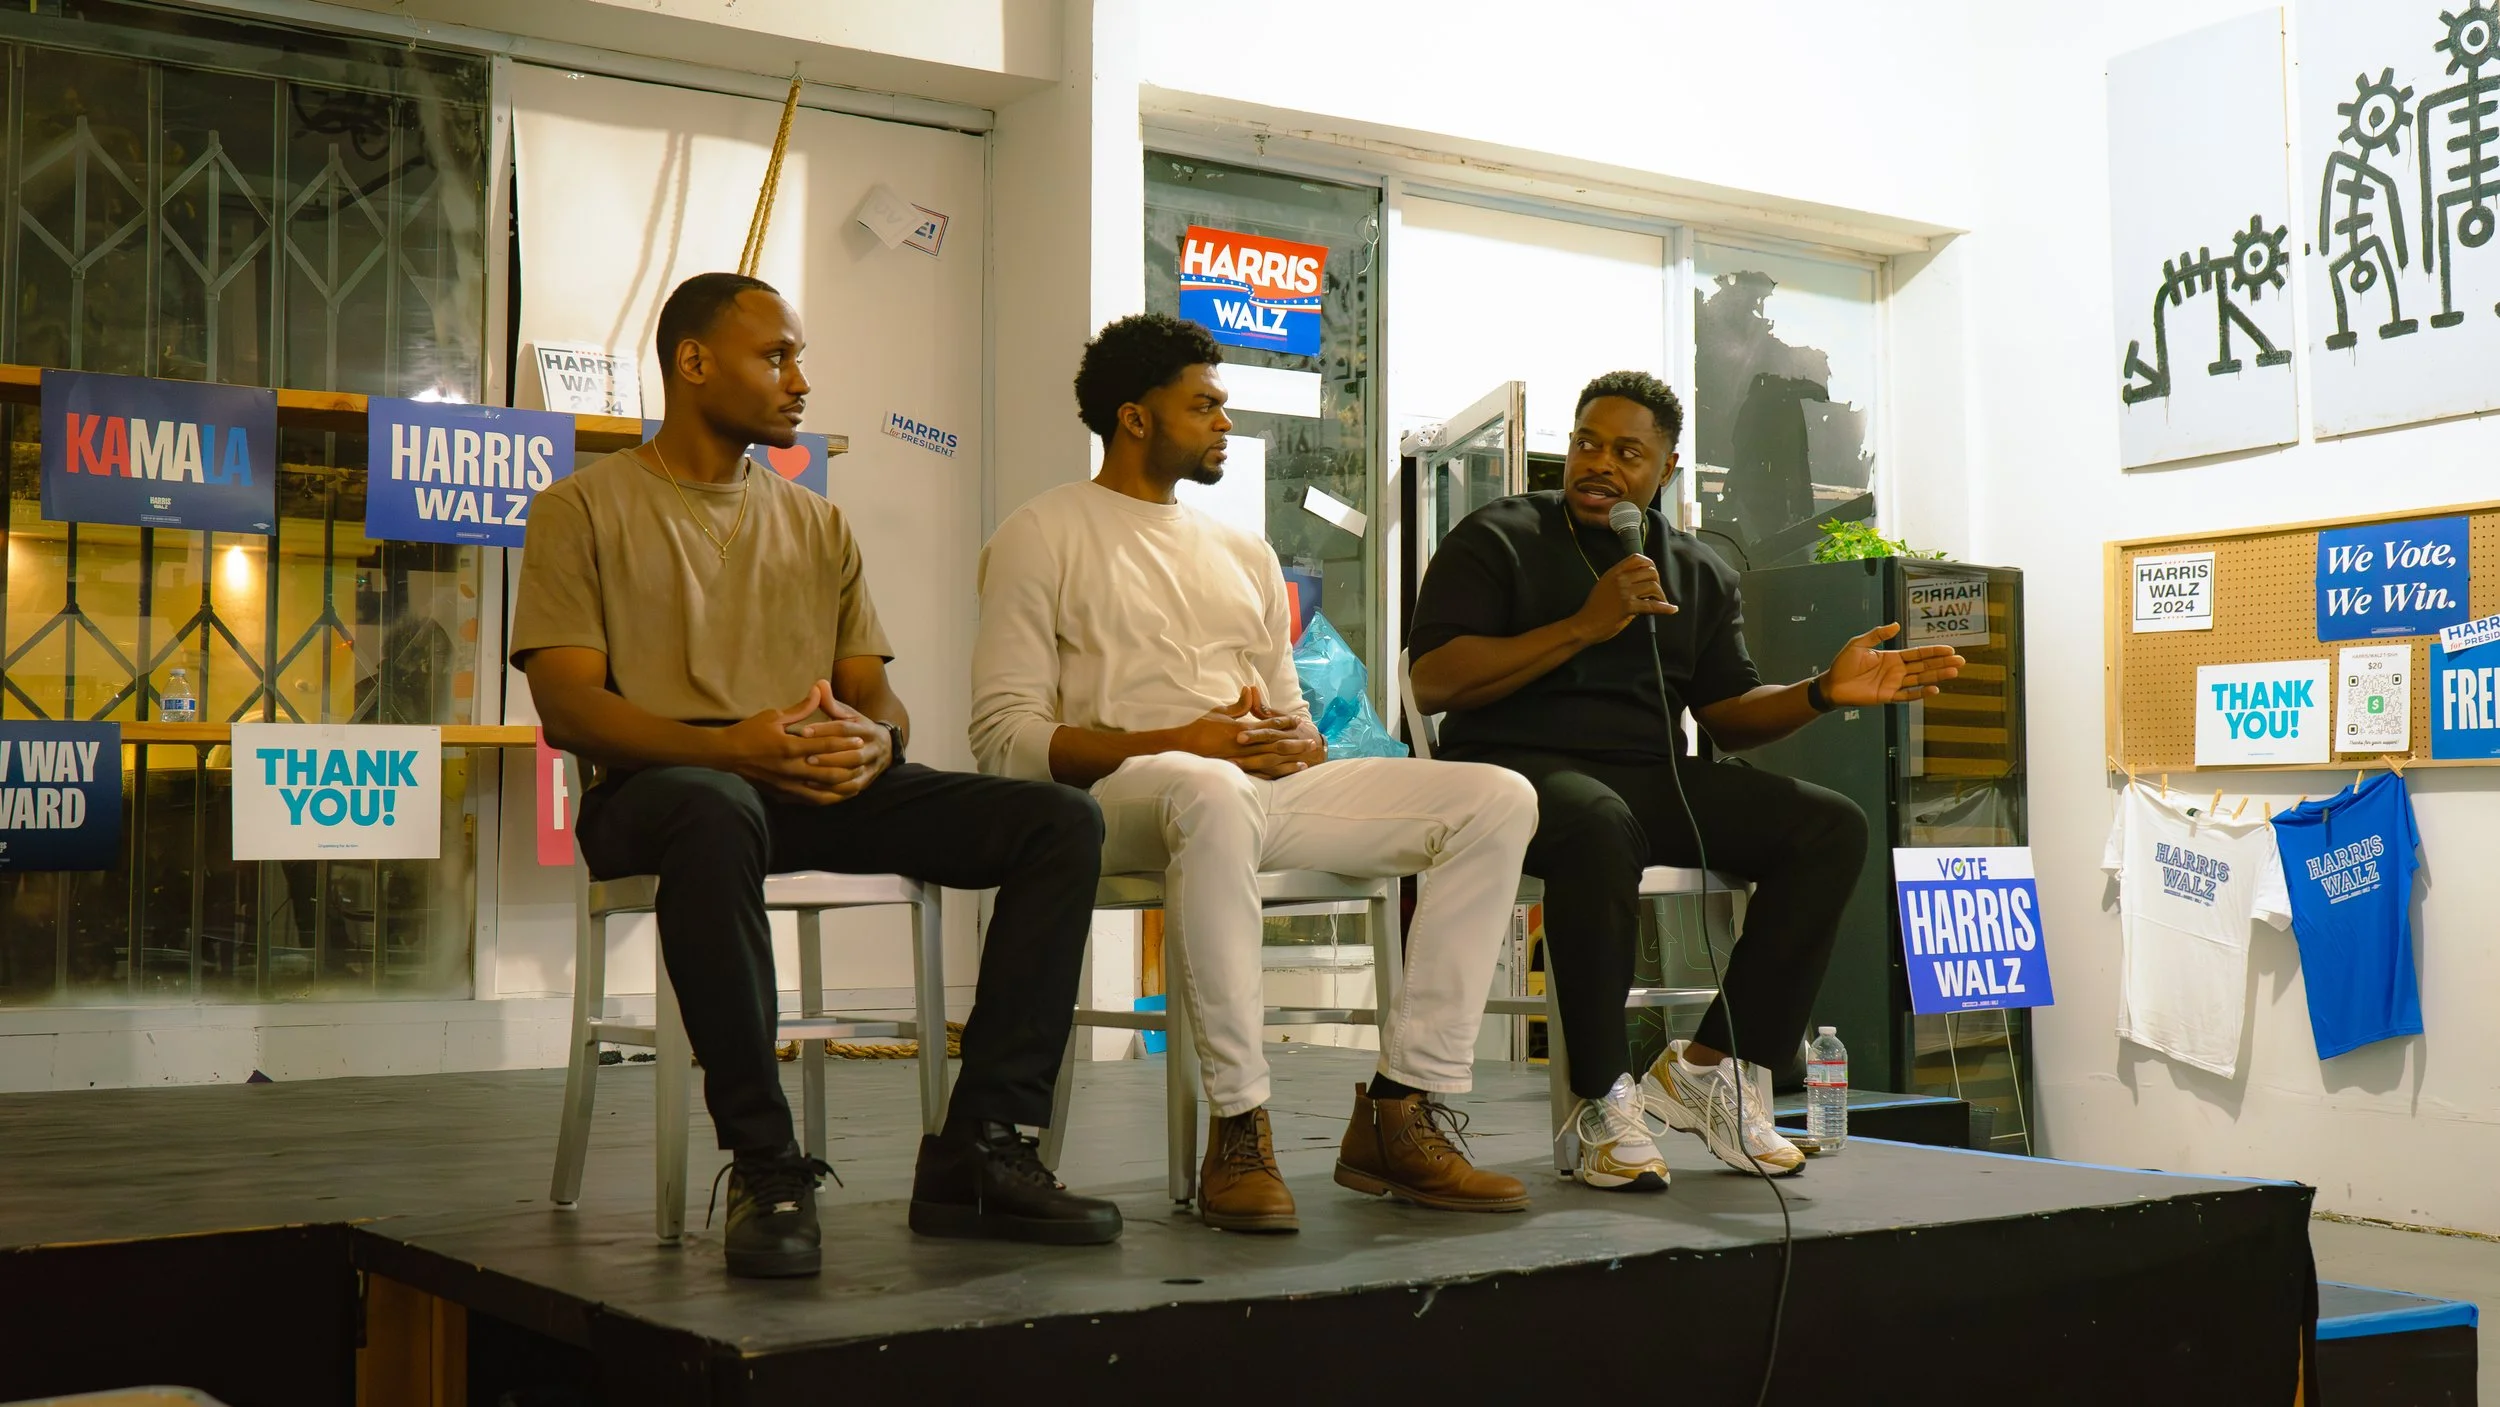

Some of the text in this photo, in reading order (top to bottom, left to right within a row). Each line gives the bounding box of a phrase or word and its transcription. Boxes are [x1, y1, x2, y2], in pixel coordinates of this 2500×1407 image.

[1184, 239, 1319, 293] HARRIS
[1213, 299, 1288, 336] WALZ
[570, 395, 624, 415] 224
[889, 428, 955, 457] for PRESIDENT
[892, 413, 958, 447] HARRIS
[67, 413, 254, 487] KAMALA
[392, 424, 553, 492] HARRIS
[415, 487, 528, 526] WALZ
[2140, 565, 2208, 582] HARRIS
[2328, 540, 2457, 575] We Vote,
[2149, 582, 2200, 598] WALZ
[2153, 600, 2194, 614] 2024
[2326, 582, 2457, 617] We Win.
[2451, 642, 2462, 650] for
[2368, 661, 2383, 670] $20
[2212, 680, 2314, 711] THANK
[2225, 710, 2299, 739] YOU!
[19, 741, 100, 782] WAY
[256, 748, 418, 787] THANK
[279, 788, 395, 826] YOU!
[1937, 857, 1989, 880] VOTE
[2155, 842, 2230, 882] HARRIS
[2306, 835, 2384, 880] HARRIS
[2163, 866, 2216, 901] WALZ
[2321, 861, 2380, 898] WALZ
[1906, 887, 2037, 955] HARRIS
[1933, 957, 2026, 998] WALZ
